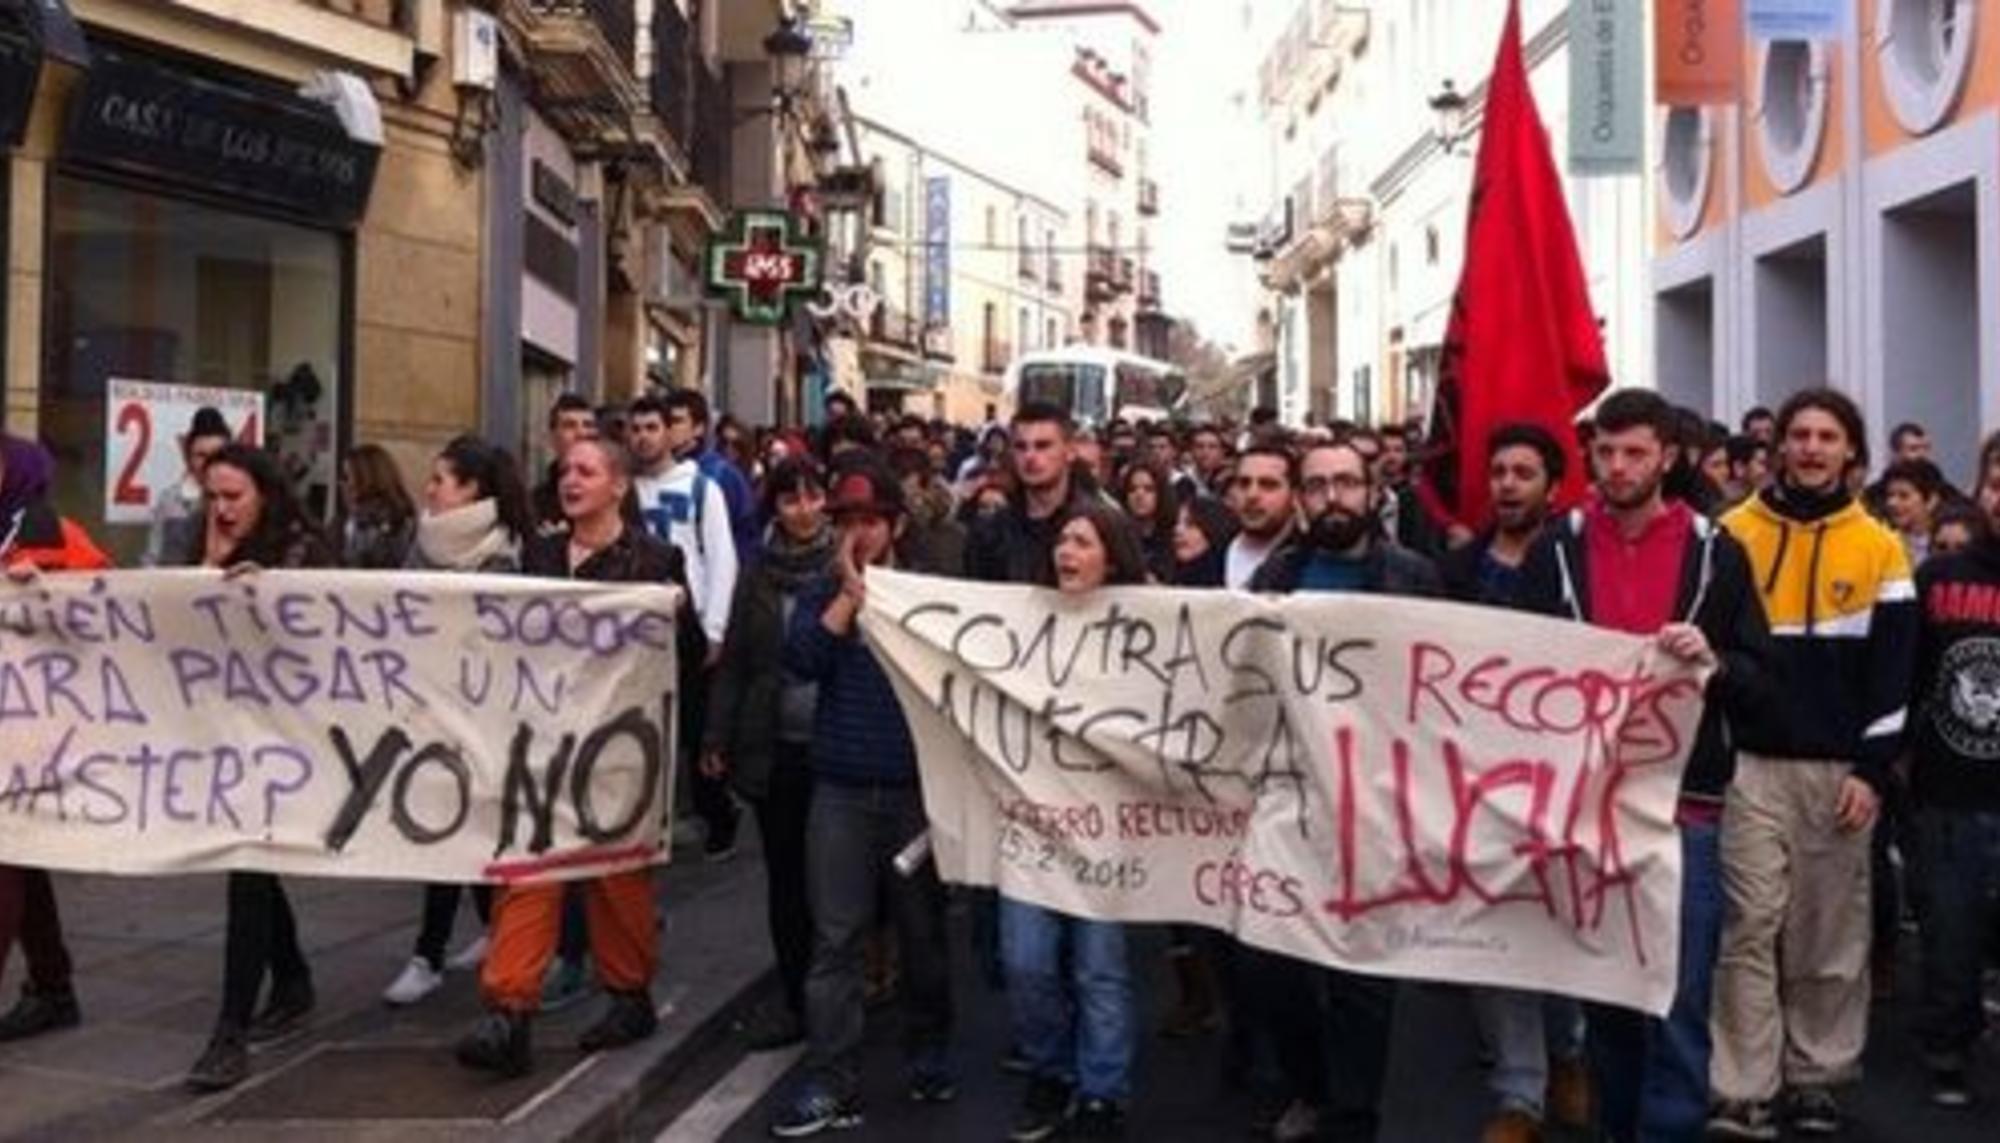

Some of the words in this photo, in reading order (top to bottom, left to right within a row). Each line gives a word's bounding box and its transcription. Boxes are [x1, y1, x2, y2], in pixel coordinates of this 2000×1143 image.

[0, 652, 148, 724] ARA
[170, 646, 428, 711] PAGAR
[459, 657, 565, 714] UN
[1220, 616, 1377, 704] SUS
[324, 723, 471, 854] YO
